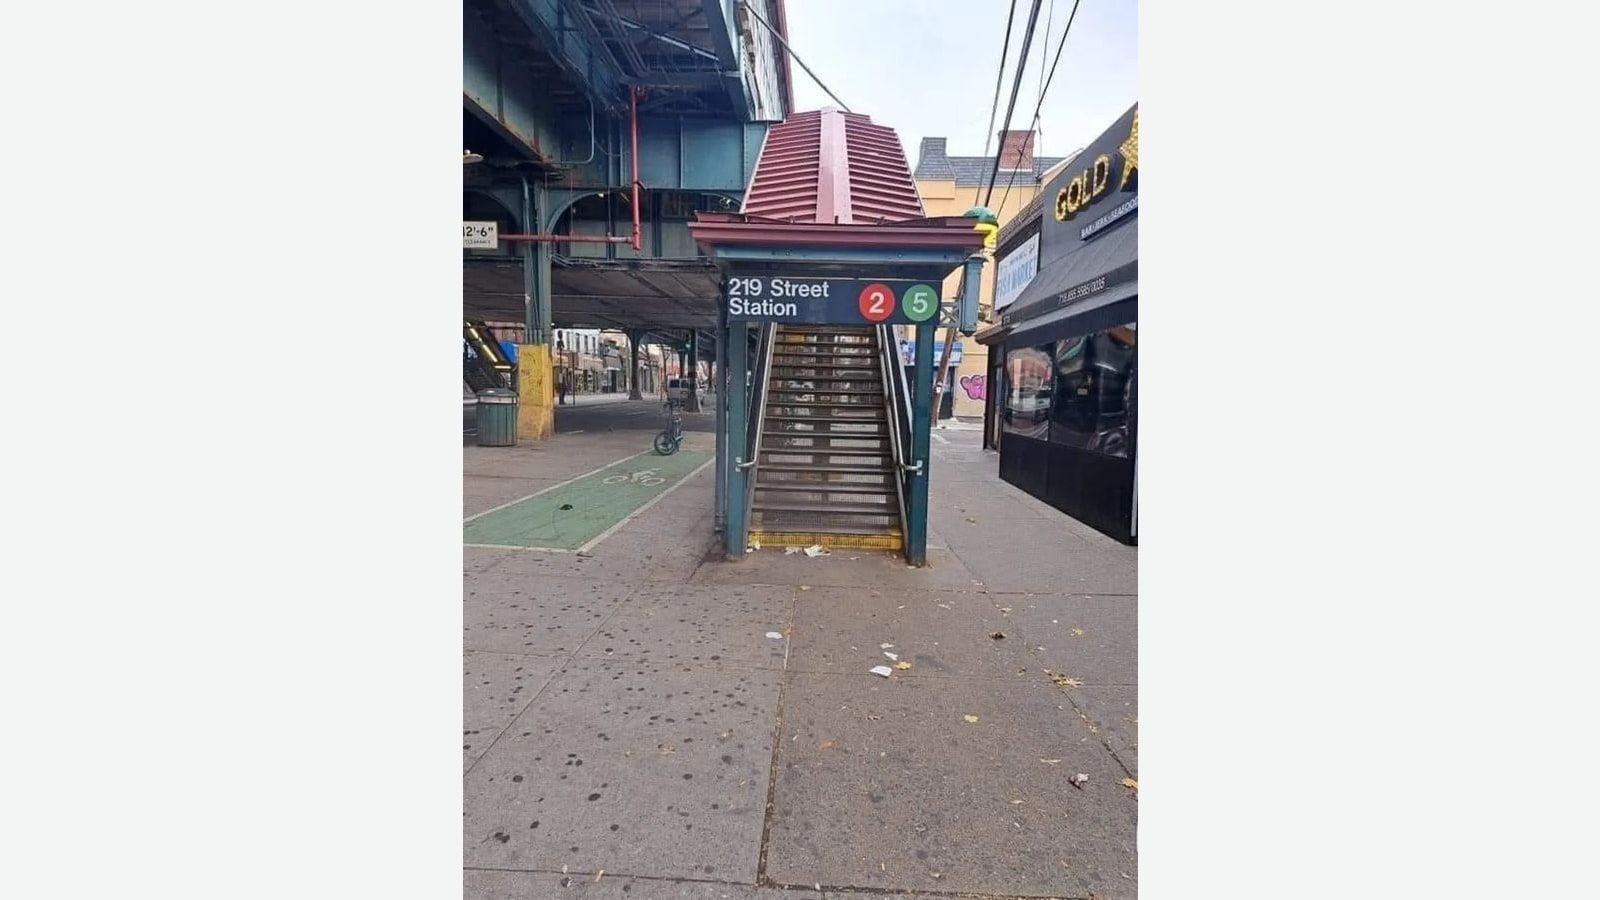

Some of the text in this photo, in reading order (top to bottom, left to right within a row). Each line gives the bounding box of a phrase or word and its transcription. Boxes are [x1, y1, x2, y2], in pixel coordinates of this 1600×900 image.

[1056, 154, 1109, 221] GOLD
[729, 278, 830, 298] 219 Street
[729, 297, 797, 317] Station
[868, 291, 928, 314] 2 5
